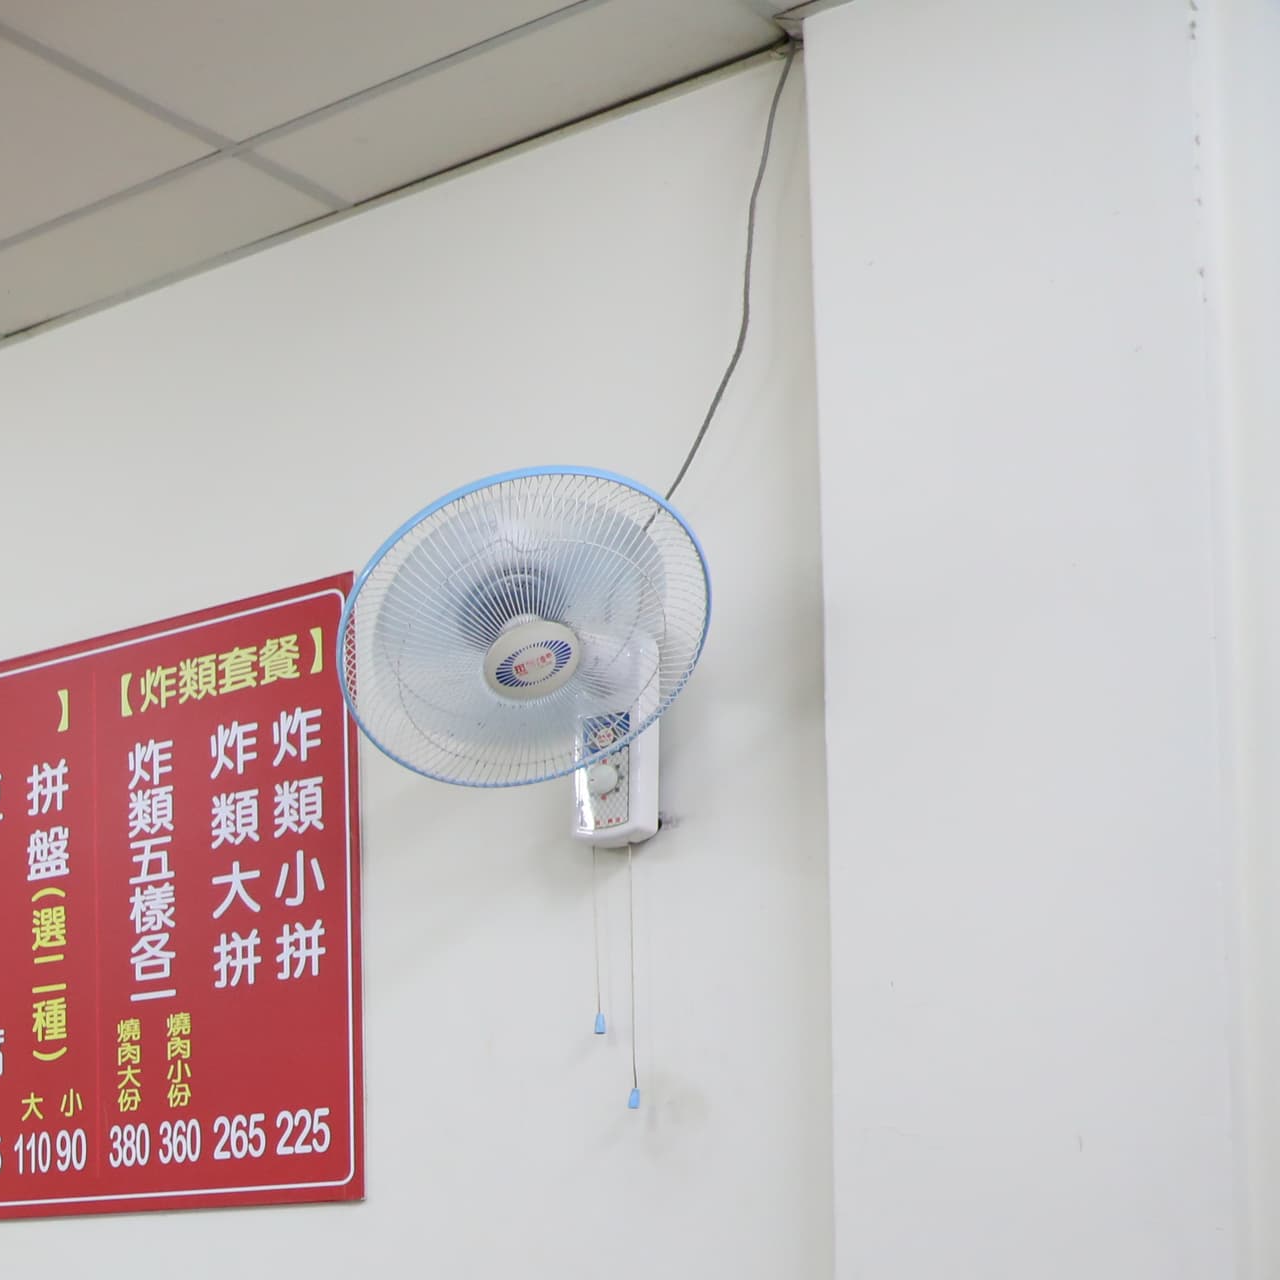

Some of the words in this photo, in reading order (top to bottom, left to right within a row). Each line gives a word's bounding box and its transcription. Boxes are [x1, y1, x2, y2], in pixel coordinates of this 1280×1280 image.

[120, 627, 324, 718] 【炸類套餐】
[127, 738, 177, 1002] 炸類五樣各一
[210, 720, 262, 989] 炸類大拼
[272, 706, 326, 980] 炸類小拼
[21, 1092, 44, 1122] 大
[60, 1088, 83, 1117] 小
[117, 1018, 142, 1113] 燒肉大份
[166, 1012, 192, 1108] 燒肉小份
[13, 1131, 51, 1175] 110
[55, 1128, 87, 1172] 90
[109, 1122, 150, 1168] 380
[158, 1118, 201, 1164] 360
[213, 1113, 266, 1160] 265
[276, 1107, 331, 1156] 225
